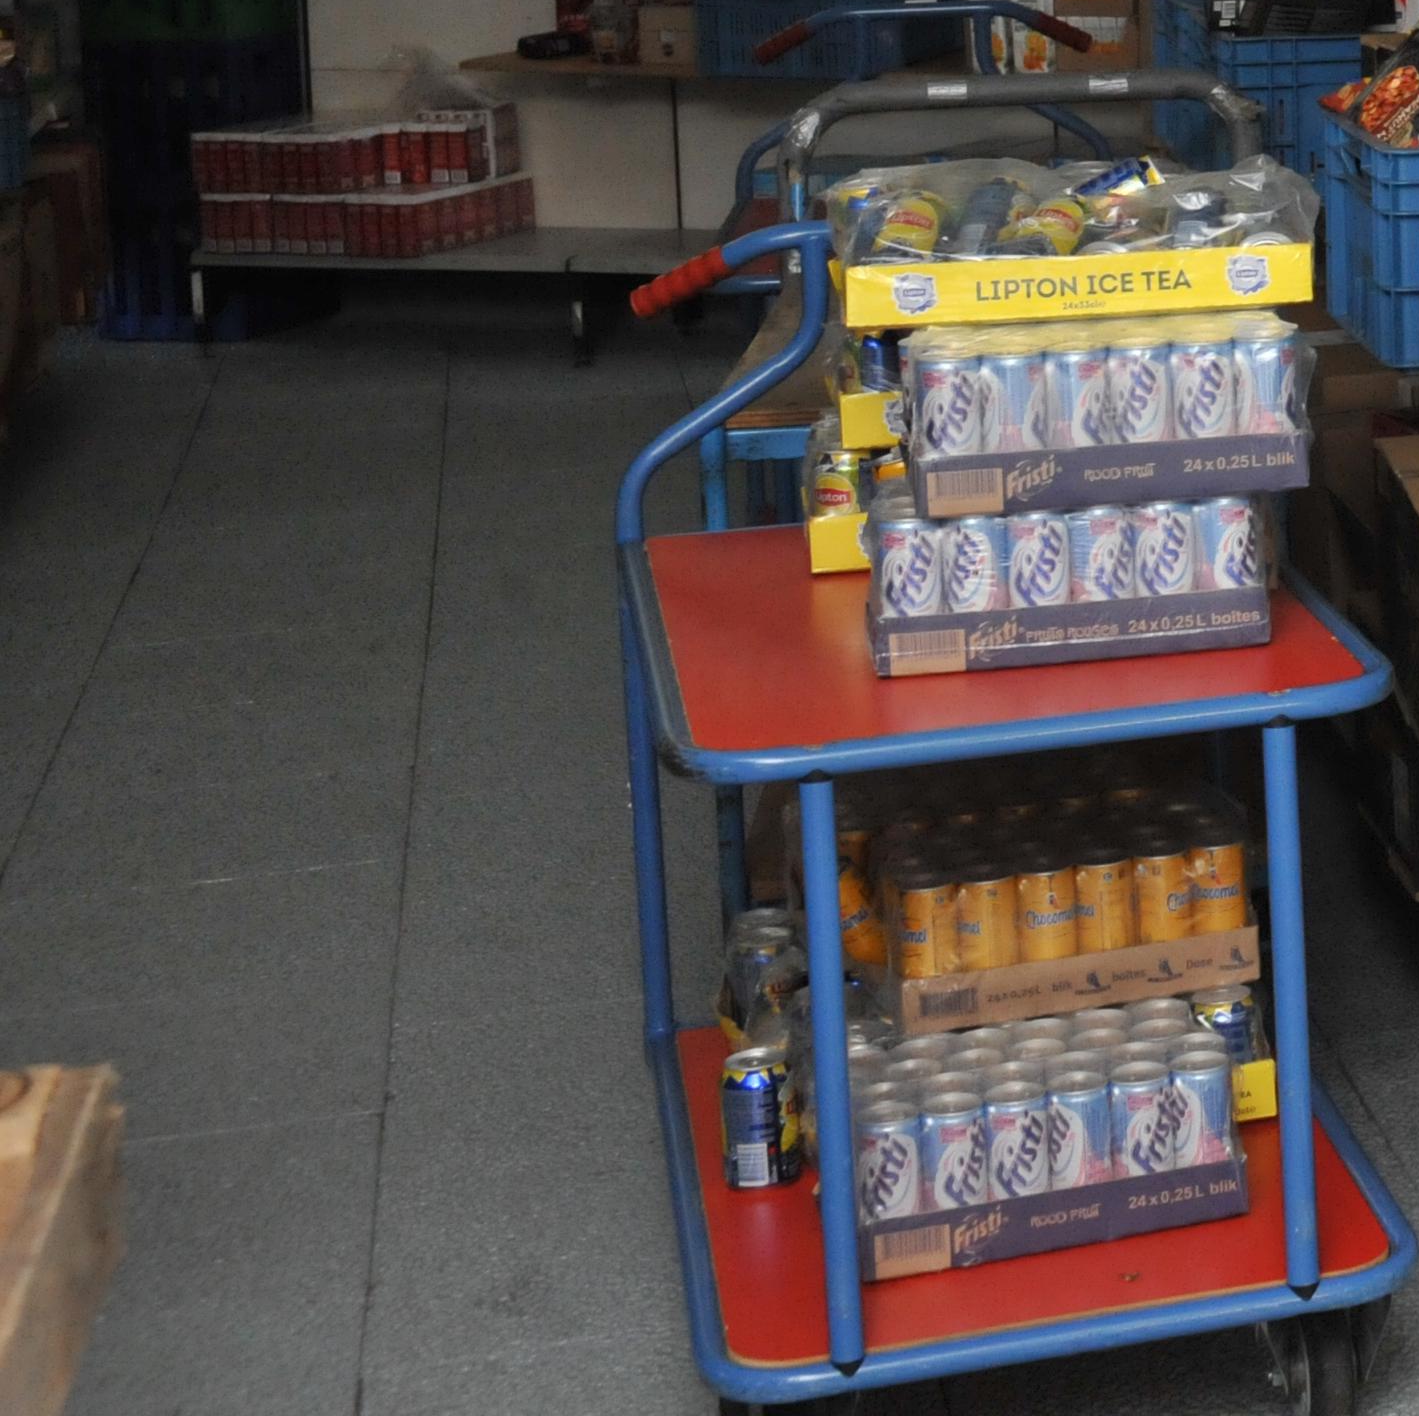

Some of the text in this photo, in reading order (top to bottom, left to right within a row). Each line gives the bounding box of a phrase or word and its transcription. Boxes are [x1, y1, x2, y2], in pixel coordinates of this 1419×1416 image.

[975, 269, 1193, 302] LIPTON ICE TEA
[924, 363, 976, 450] Fristi
[1177, 352, 1226, 436] Fristi
[1005, 455, 1056, 500] Fristi
[1084, 466, 1121, 481] ROOD
[1183, 458, 1203, 472] 24
[1264, 451, 1296, 468] blik
[886, 528, 936, 616] Fristi
[1016, 511, 1065, 602] Fristi
[1138, 502, 1187, 597] Fristi
[1128, 618, 1149, 633] 24
[996, 1111, 1046, 1198] Fristi
[953, 1208, 1004, 1253] Fristi
[1128, 1194, 1147, 1209] 24
[1208, 1179, 1238, 1196] blik
